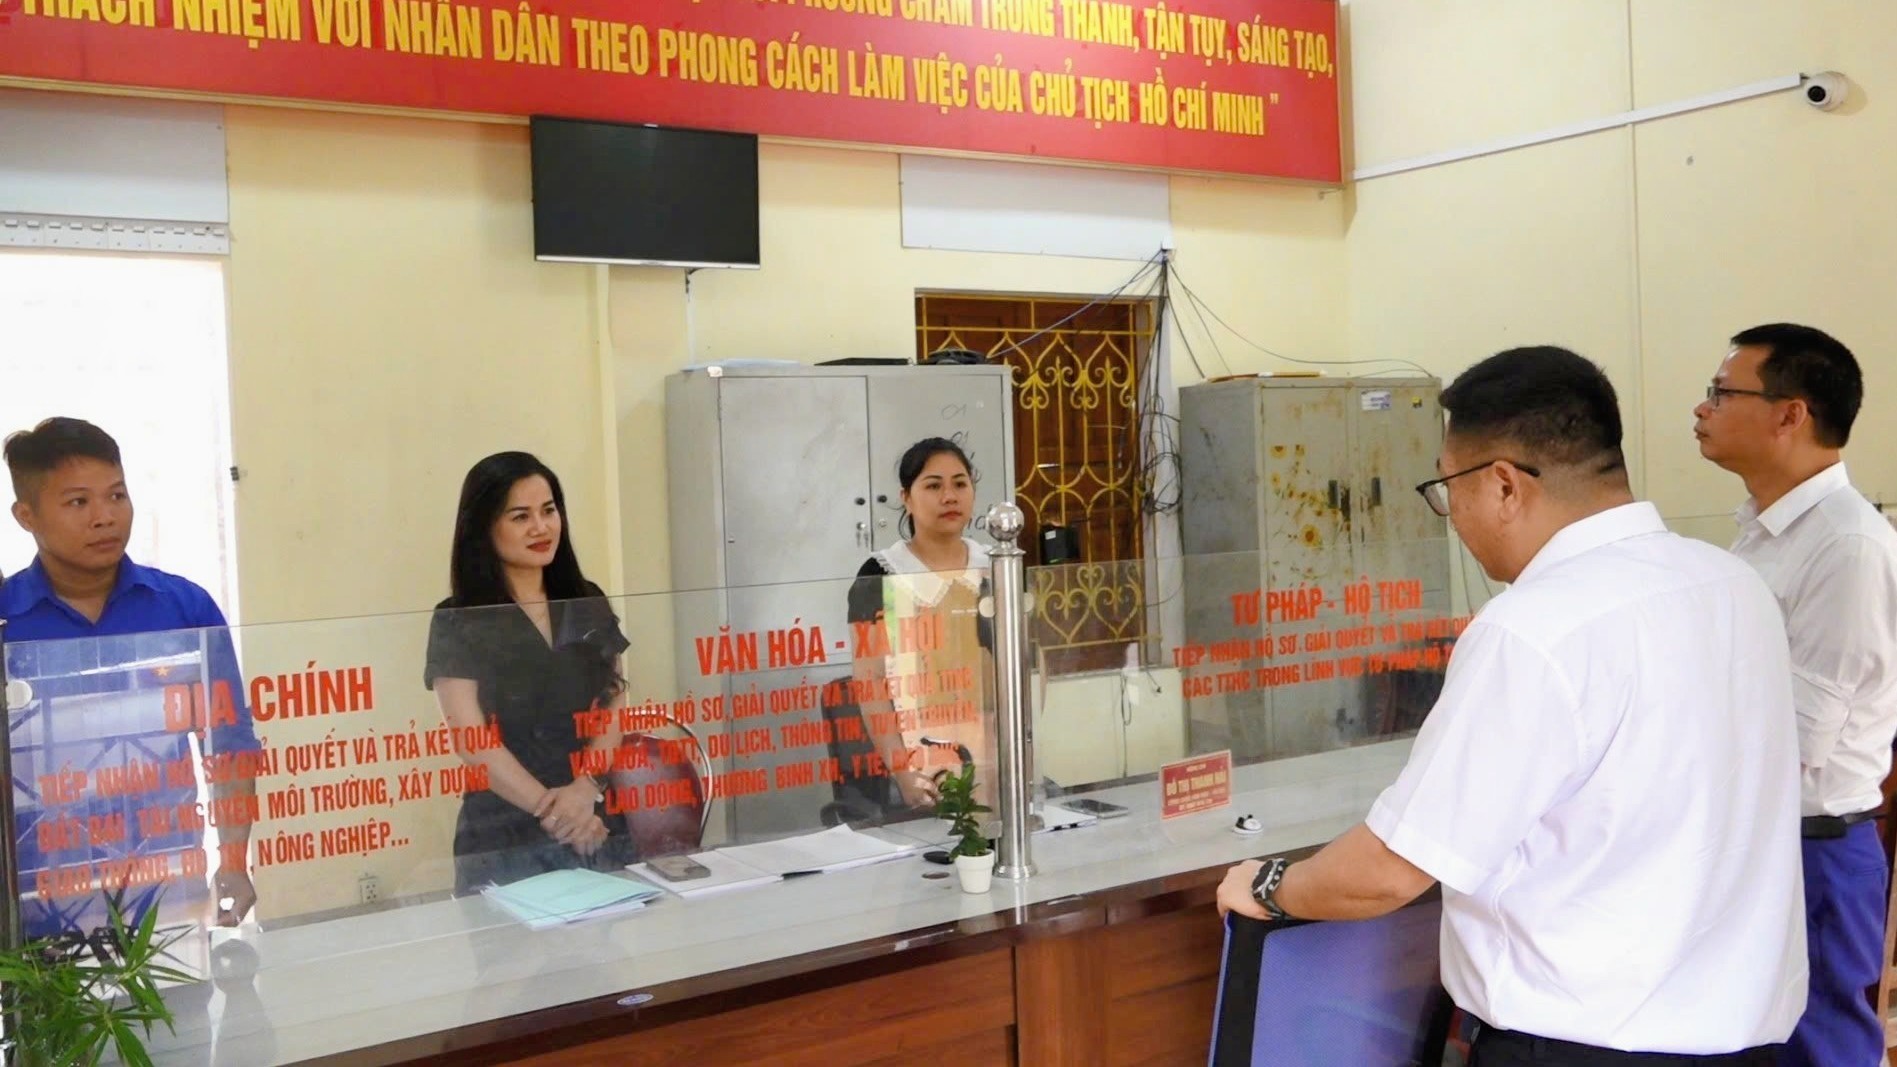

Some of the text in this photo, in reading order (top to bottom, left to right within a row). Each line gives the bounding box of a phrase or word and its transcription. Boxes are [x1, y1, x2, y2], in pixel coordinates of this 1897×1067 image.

[384, 0, 482, 59] NHÂN
[491, 1, 560, 66] DÂN
[571, 18, 649, 76] THEO
[658, 28, 758, 86] PHONG
[766, 31, 839, 95] CÁCH
[848, 42, 905, 101] LÀM
[912, 52, 969, 114] VIỆC
[975, 53, 1024, 113] CỦA
[1029, 57, 1077, 117] CHỦ
[1081, 76, 1131, 129] TỊCH
[1139, 67, 1168, 126] HỒ
[1172, 81, 1207, 130] CHÍ
[1212, 91, 1265, 135] MINH
[1143, 1, 1185, 60] TẬN
[1189, 13, 1233, 66] TỤY,
[1236, 14, 1289, 67] SÁNG
[1294, 29, 1334, 78] TẠO,
[1230, 588, 1261, 626] TƯ
[1266, 581, 1323, 624] PHÁP
[1344, 574, 1372, 620] HỘ
[1377, 579, 1423, 617] TỊCH
[695, 604, 945, 677] VĂN HÓA - XÃ HỘI
[1172, 638, 1206, 669] TIẾP
[162, 660, 374, 740] ĐỊA CHÍNH
[573, 697, 612, 739] TIẾP
[619, 697, 668, 735] NHẬN
[673, 689, 696, 726] HỒ
[732, 683, 765, 719] GIẢI
[769, 676, 818, 716] QUYẾT
[848, 670, 875, 704] TRẢ
[1182, 671, 1213, 699] CÁC
[1255, 663, 1301, 689] TRONG
[38, 759, 88, 806] TIẾP
[95, 757, 161, 798] NHẬN
[285, 727, 348, 777] QUYẾT
[352, 728, 379, 765] VÀ
[383, 719, 421, 762] TRẢ
[425, 715, 460, 758] KẾT
[464, 712, 503, 754] QUẢ
[569, 744, 608, 779] VĂN
[708, 734, 730, 759] DU
[735, 728, 777, 759] LỊCH,
[780, 716, 833, 749] THÔNG
[836, 715, 867, 743] TIN,
[267, 783, 306, 820] MÔI
[311, 774, 395, 815] TRƯỜNG,
[398, 767, 433, 802] XÂY
[440, 763, 490, 800] DỰNG
[605, 782, 640, 816] LAO
[775, 761, 815, 791] BINH
[851, 753, 864, 780] Y
[258, 830, 315, 868] NÔNG
[320, 817, 410, 860] NGHIỆP...
